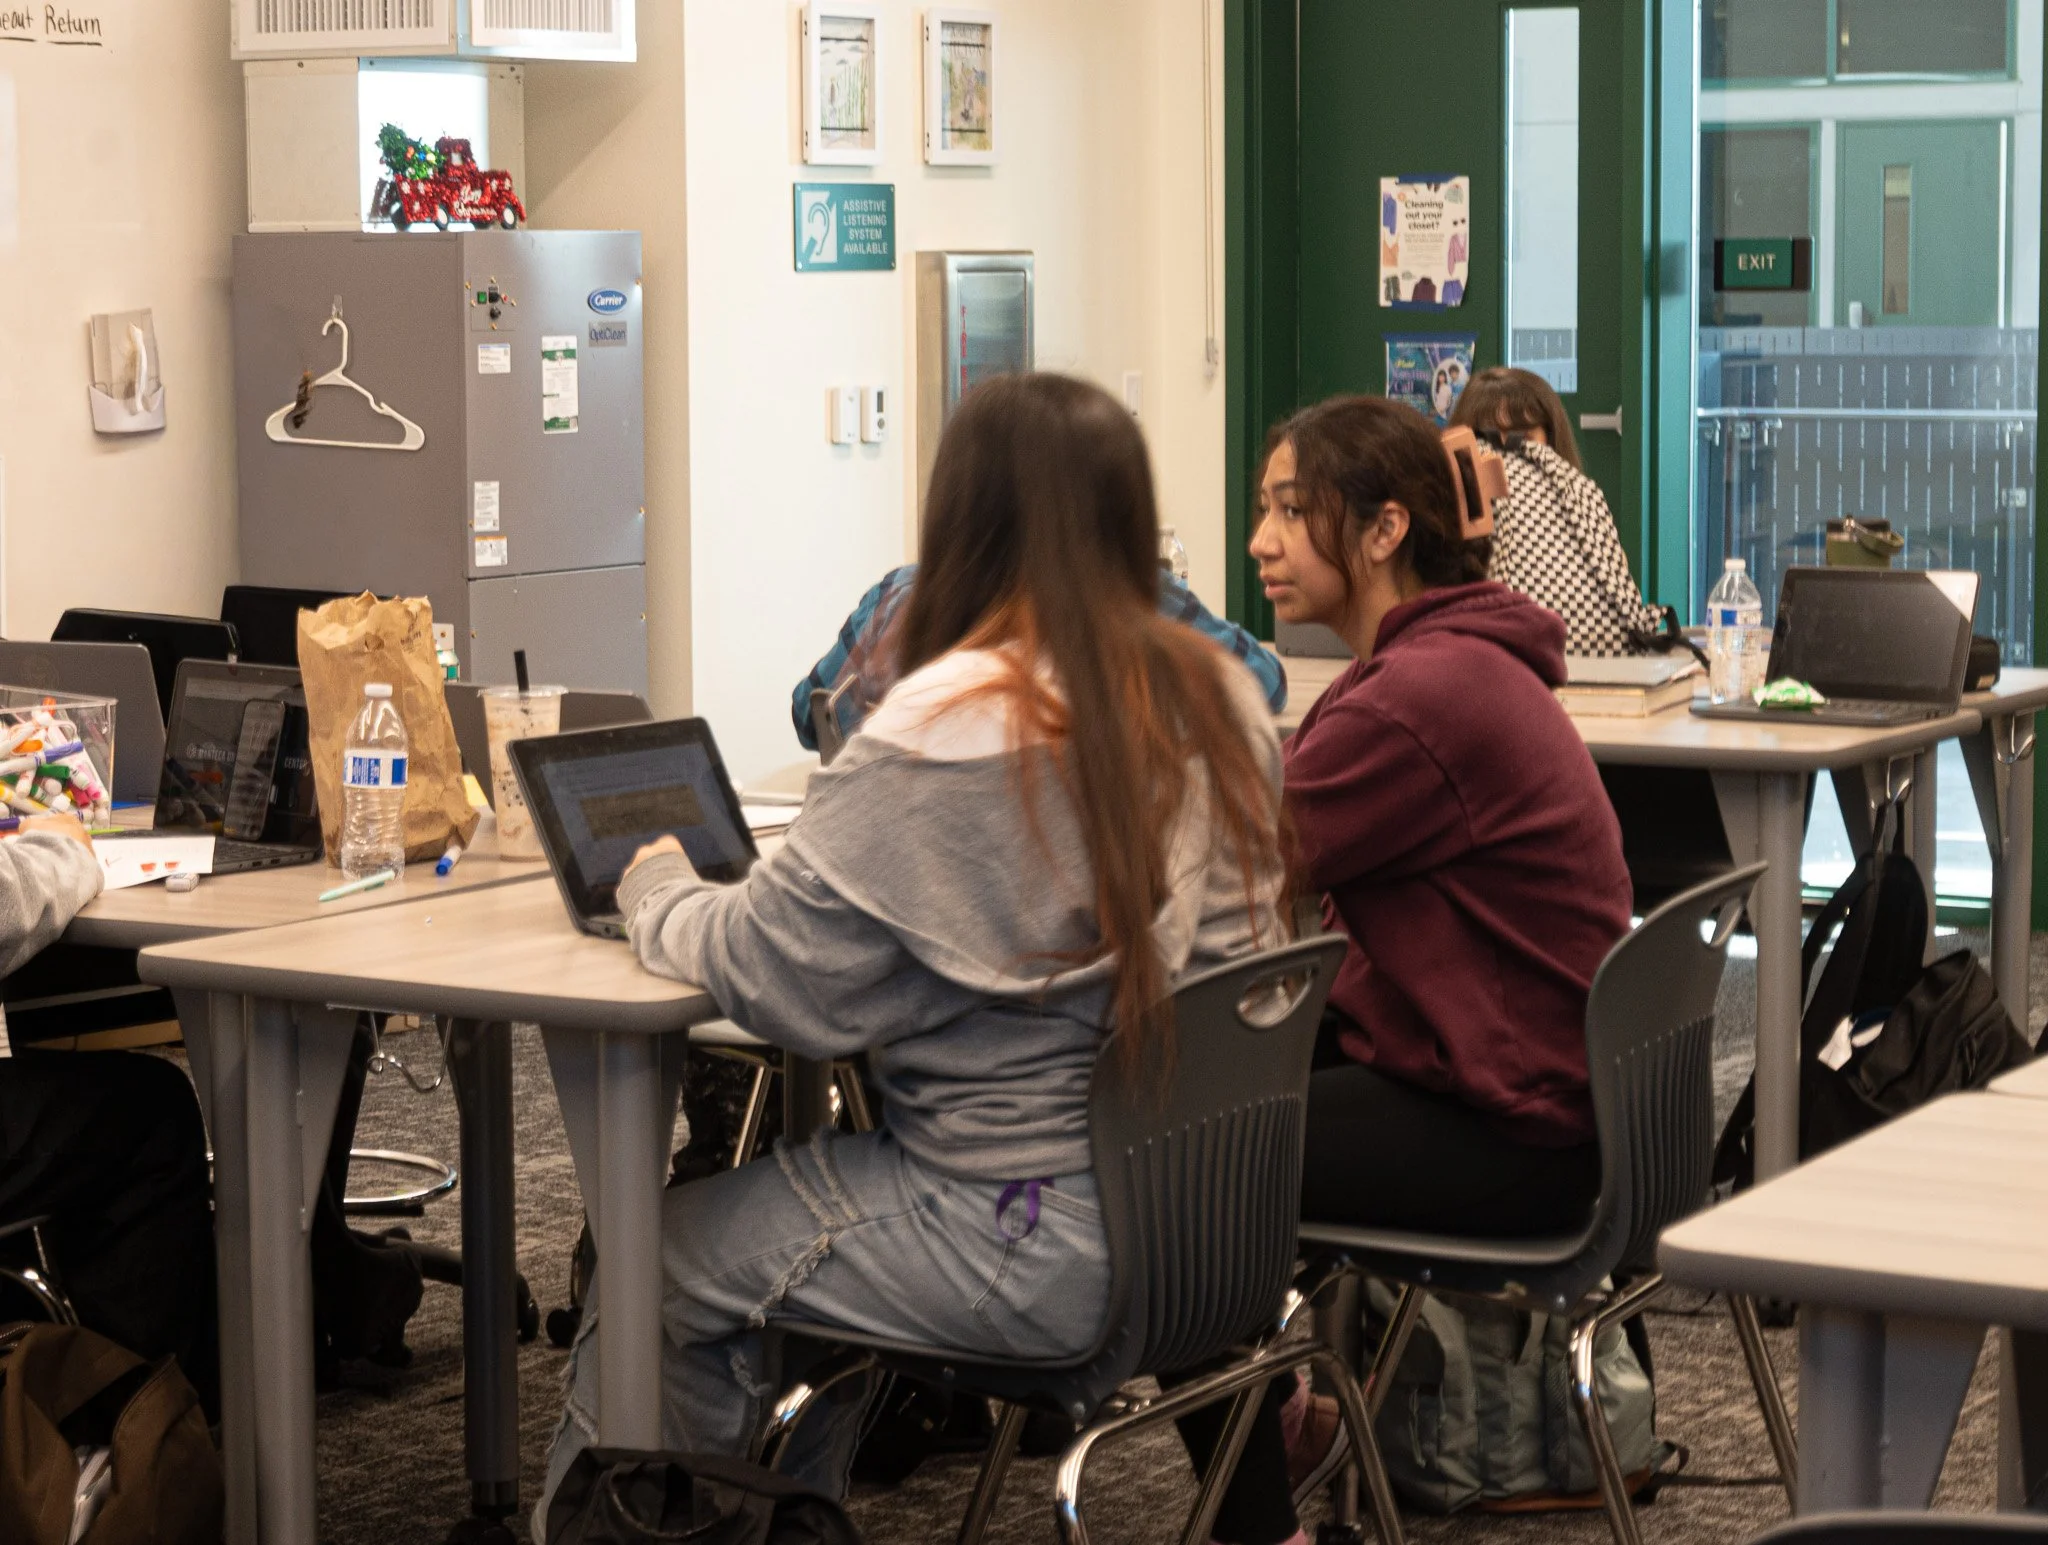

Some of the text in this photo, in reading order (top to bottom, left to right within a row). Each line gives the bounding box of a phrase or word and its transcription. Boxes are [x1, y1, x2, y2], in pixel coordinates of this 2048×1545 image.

[0, 4, 102, 37] eout Return
[843, 199, 887, 212] ASSISTIVE
[1404, 200, 1444, 210] Cleaning
[843, 213, 887, 226] LISTENING
[1405, 211, 1442, 221] out your
[1408, 221, 1440, 231] closet?
[848, 228, 883, 241] SYSTEM
[843, 242, 888, 255] AVAILABLE
[1738, 253, 1776, 271] EXIT
[593, 294, 624, 307] Carrier
[589, 326, 626, 343] OptiClean
